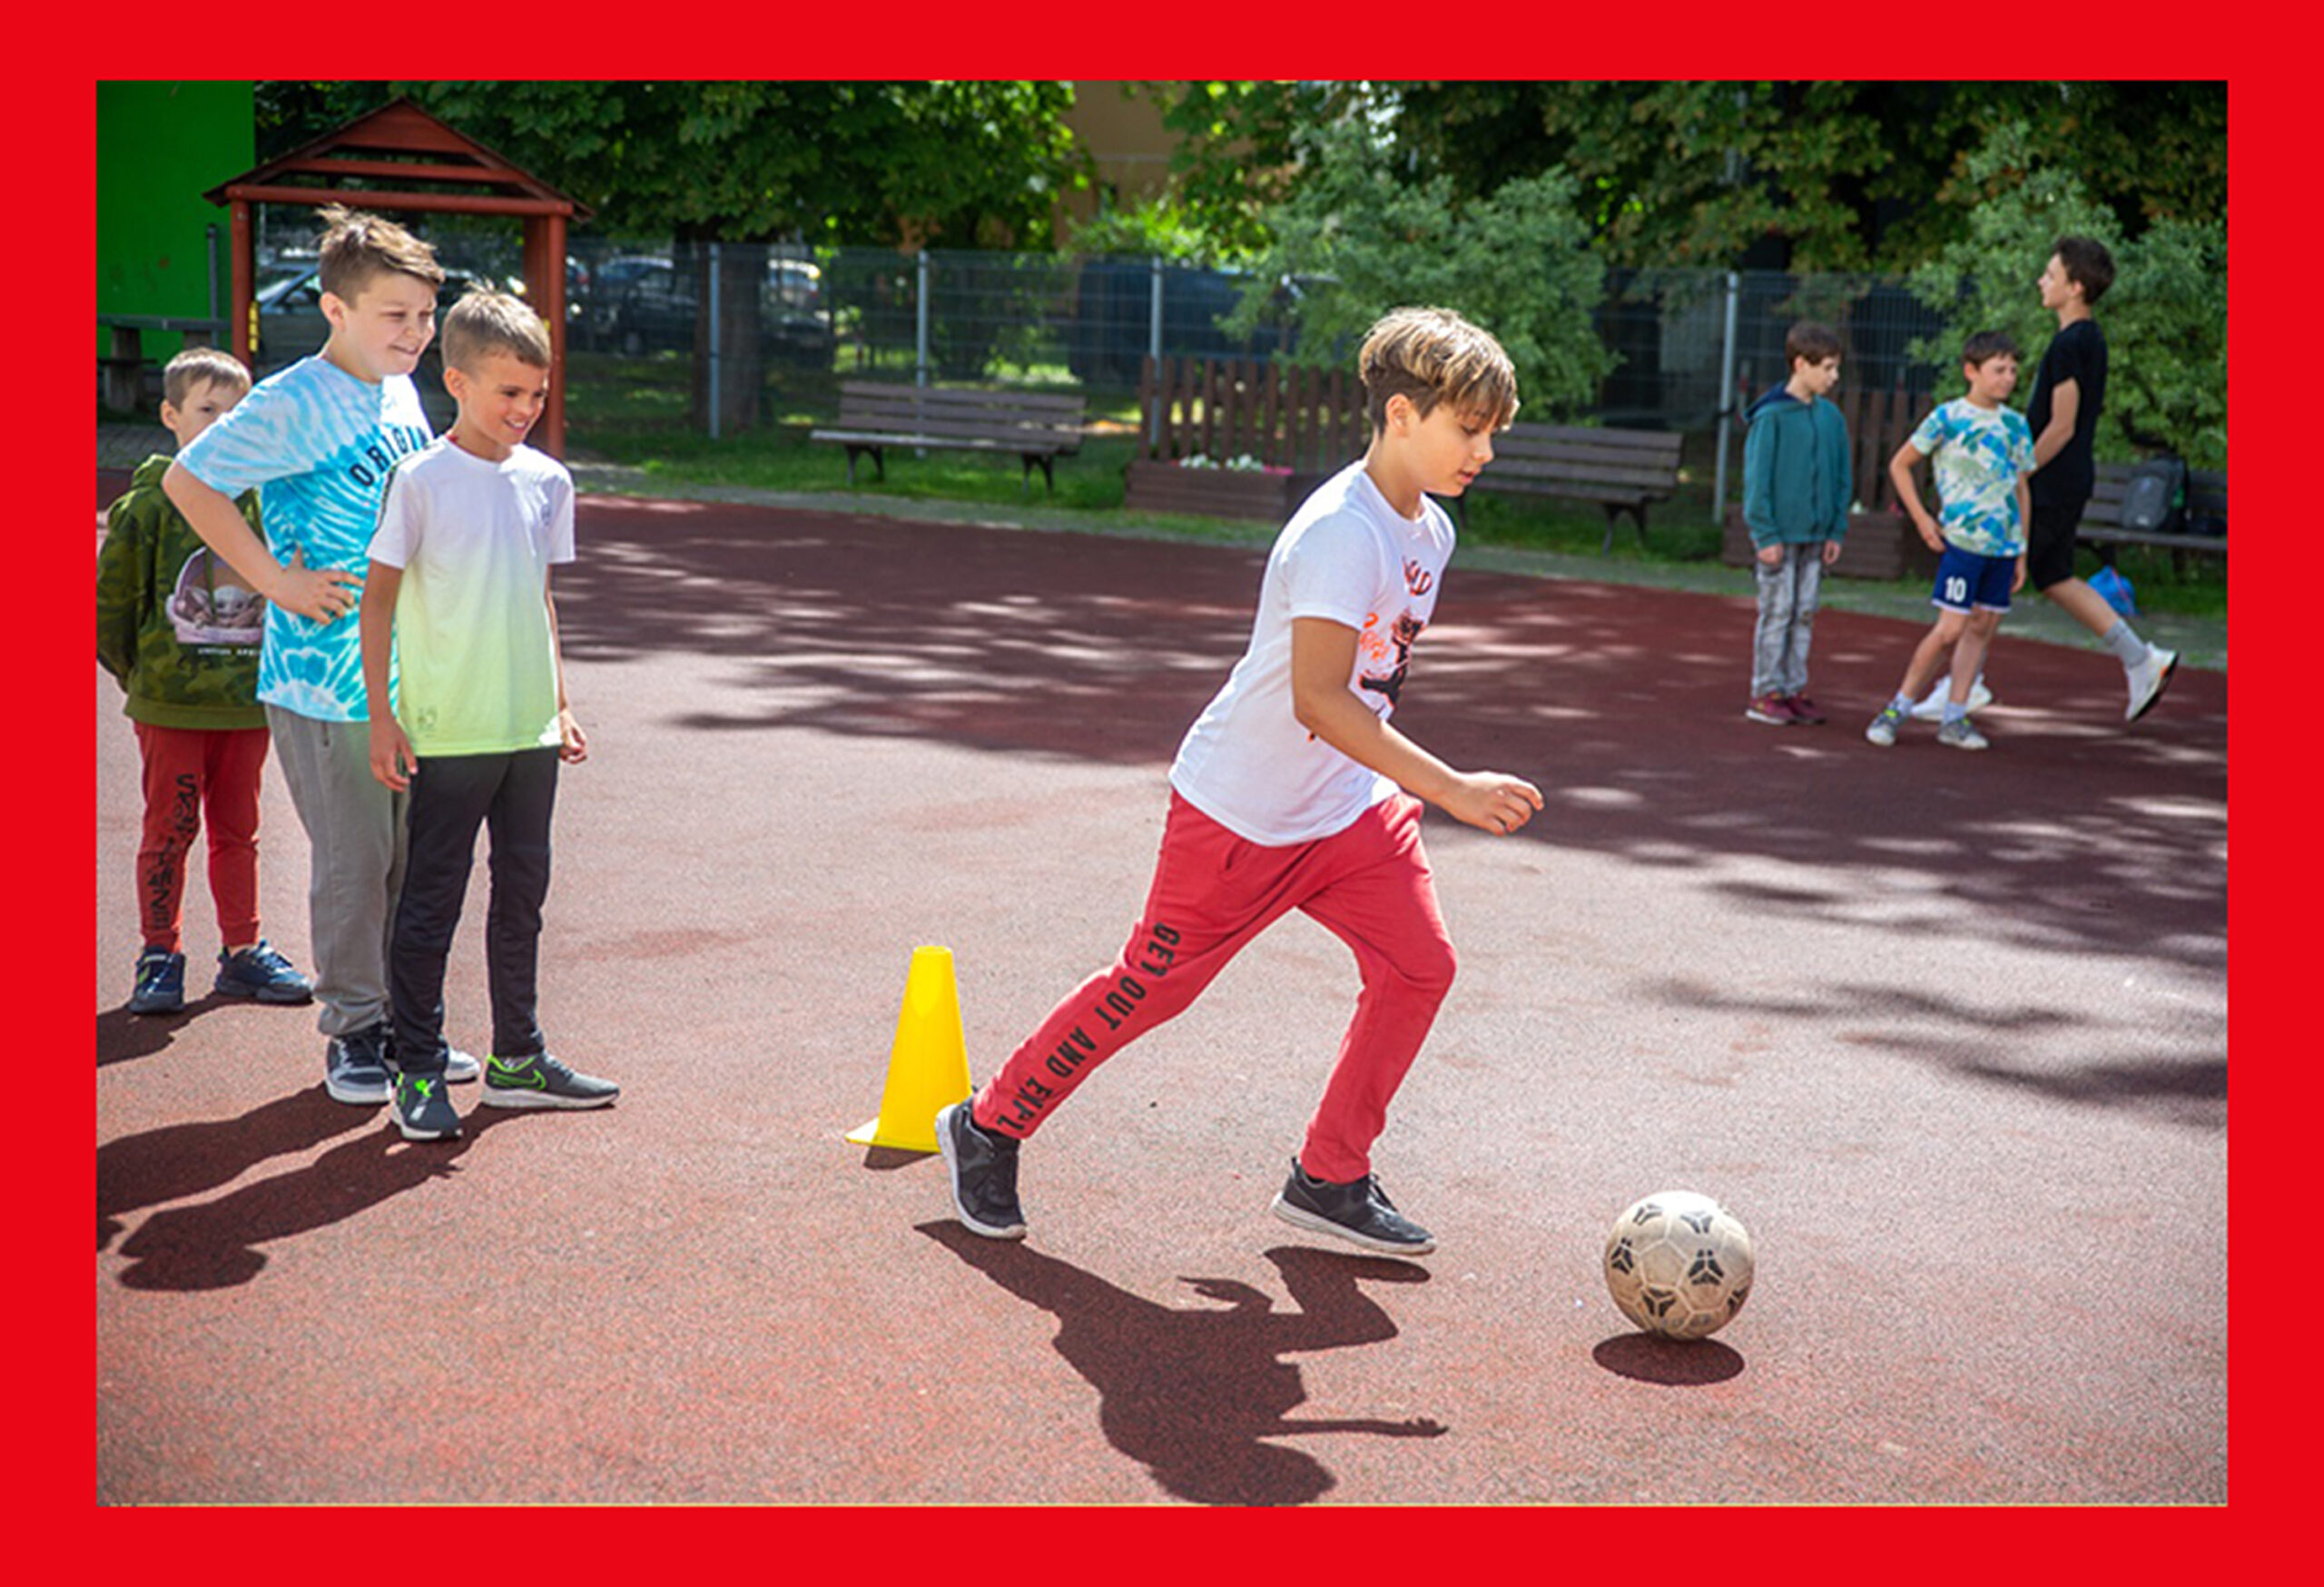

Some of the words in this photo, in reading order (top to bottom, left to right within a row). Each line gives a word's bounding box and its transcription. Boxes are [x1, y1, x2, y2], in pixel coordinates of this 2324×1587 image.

[1945, 577, 1966, 602] 10
[1095, 976, 1147, 1030] OUT
[1046, 1026, 1097, 1079] AND
